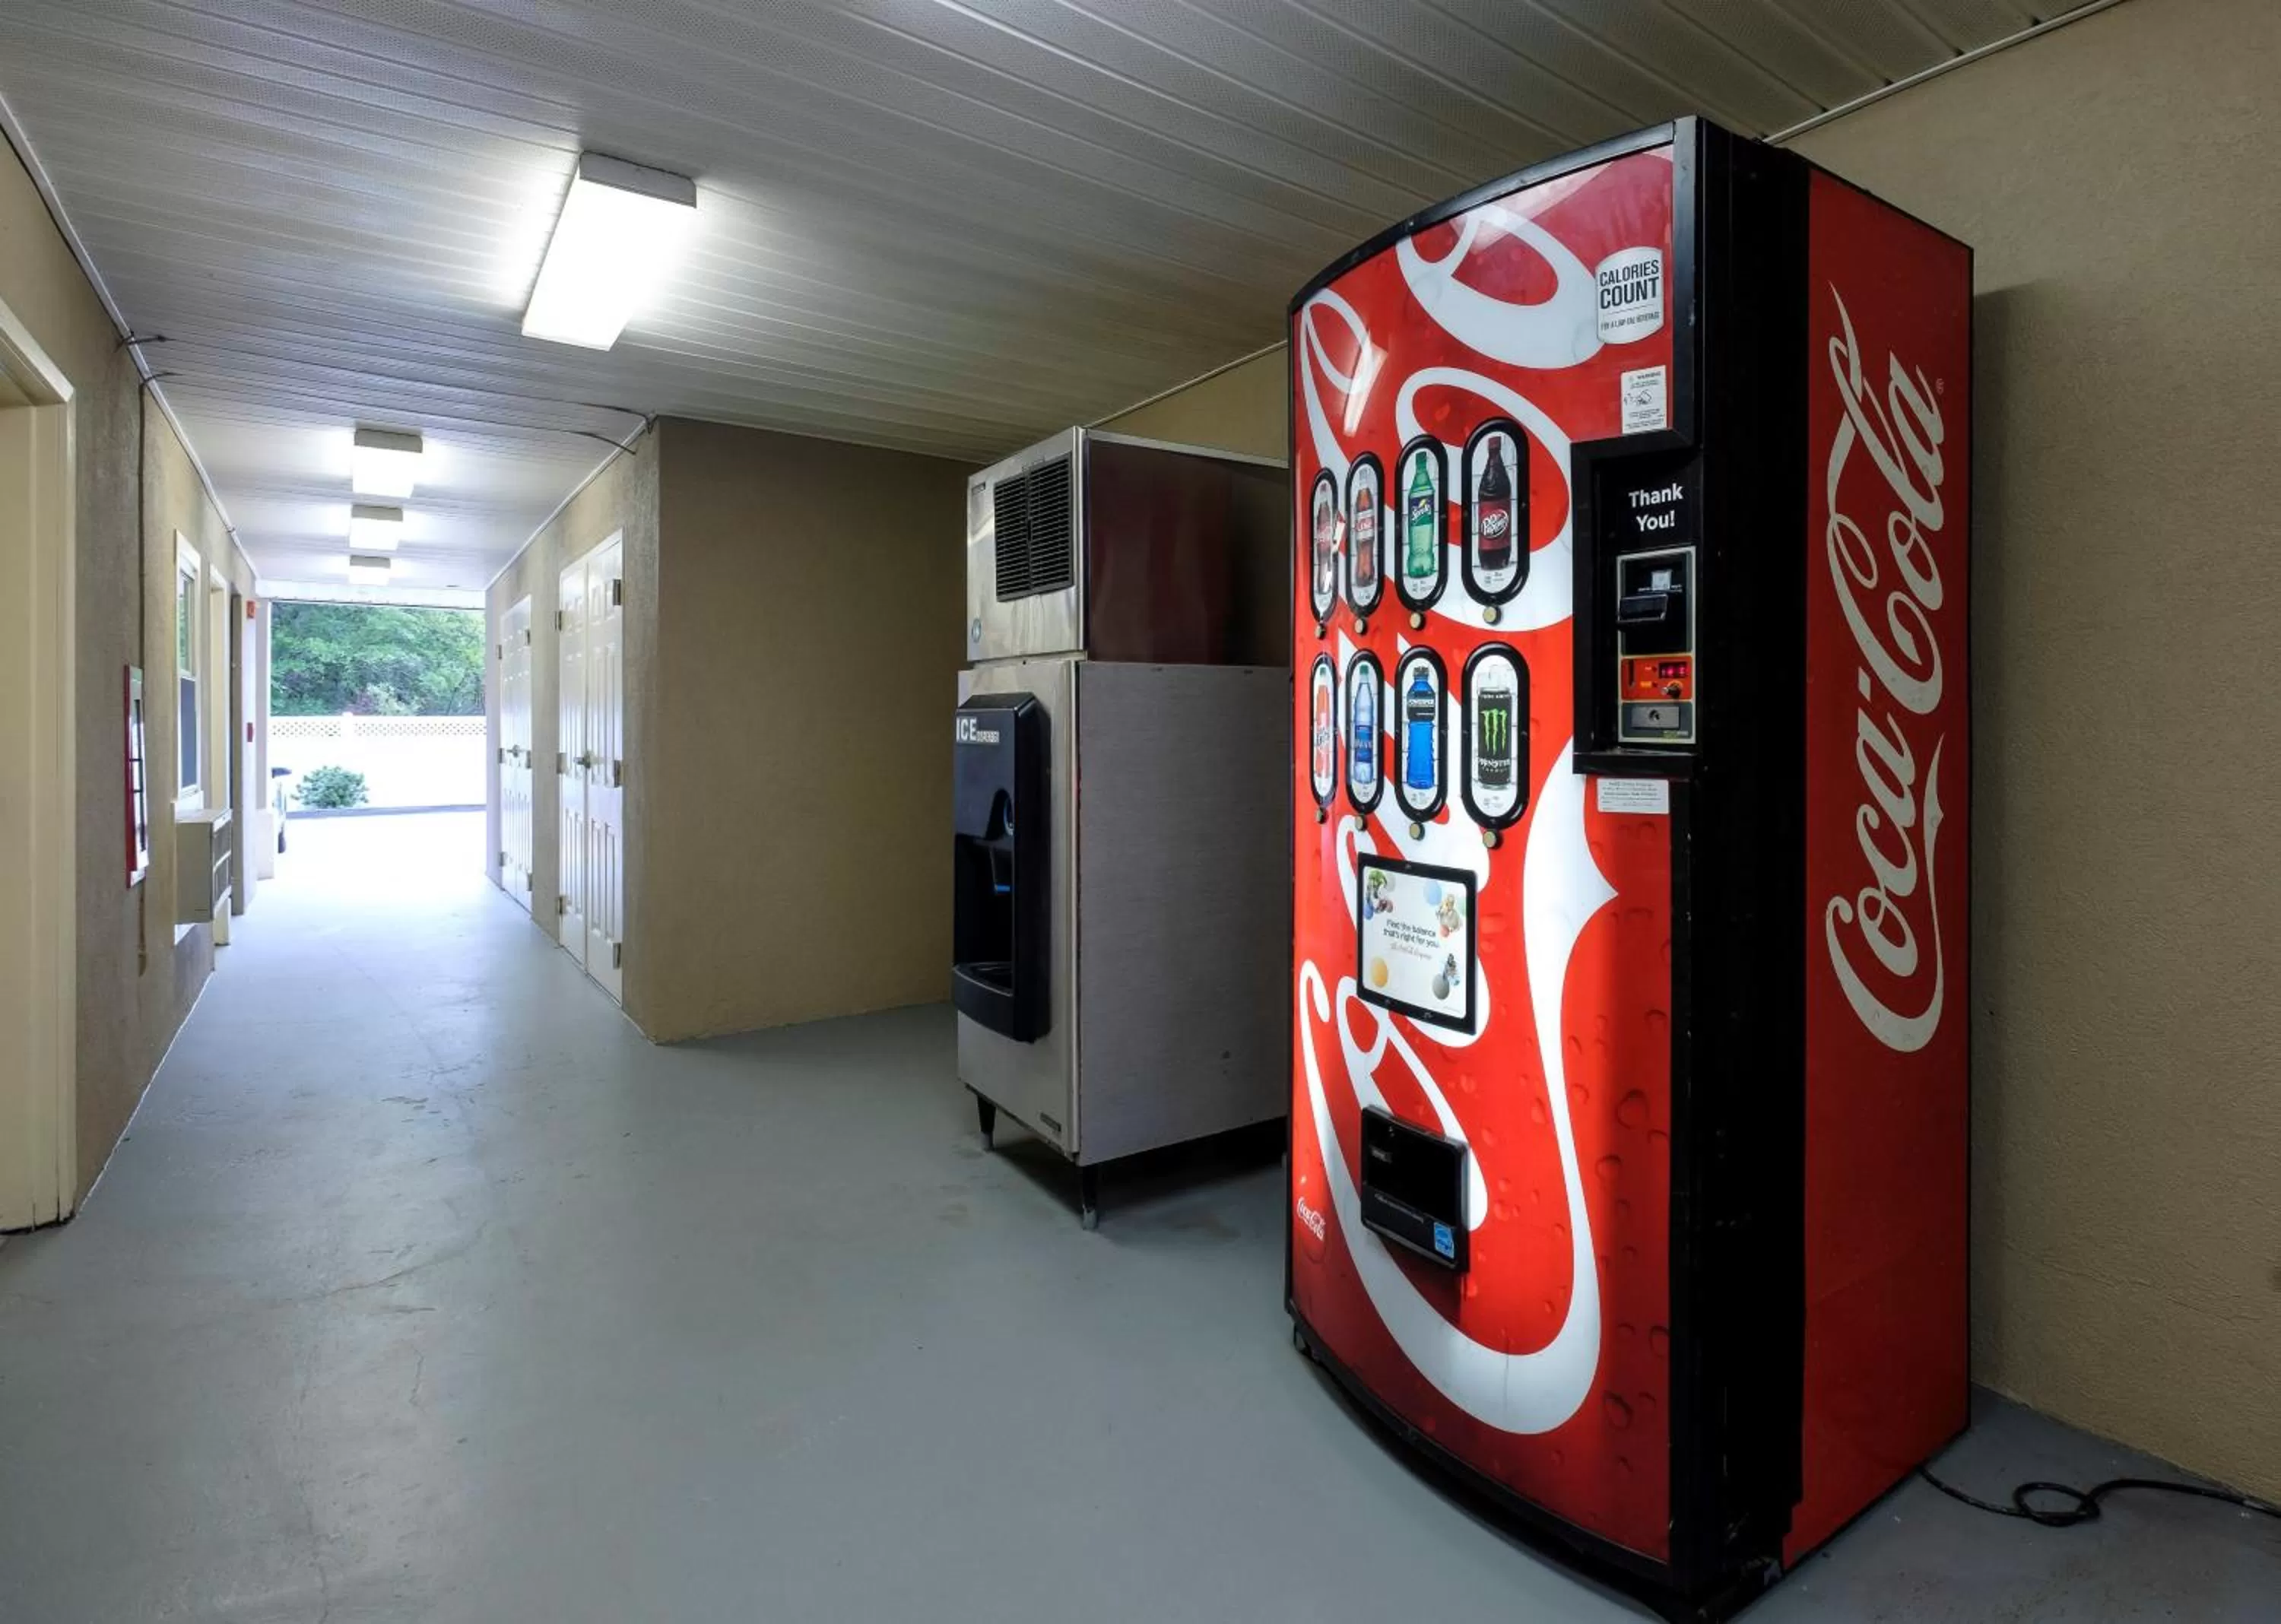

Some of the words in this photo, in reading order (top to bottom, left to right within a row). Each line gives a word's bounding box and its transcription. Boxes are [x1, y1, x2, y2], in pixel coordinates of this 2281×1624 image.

[1600, 259, 1660, 287] CALORIES
[1600, 276, 1660, 309] COUNT
[1629, 483, 1683, 508] Thank
[1411, 504, 1431, 524] Sprite
[1636, 509, 1675, 532] You!
[1826, 280, 1944, 1053] Coca-Cola
[956, 717, 977, 742] ICE
[1413, 925, 1436, 937] balance
